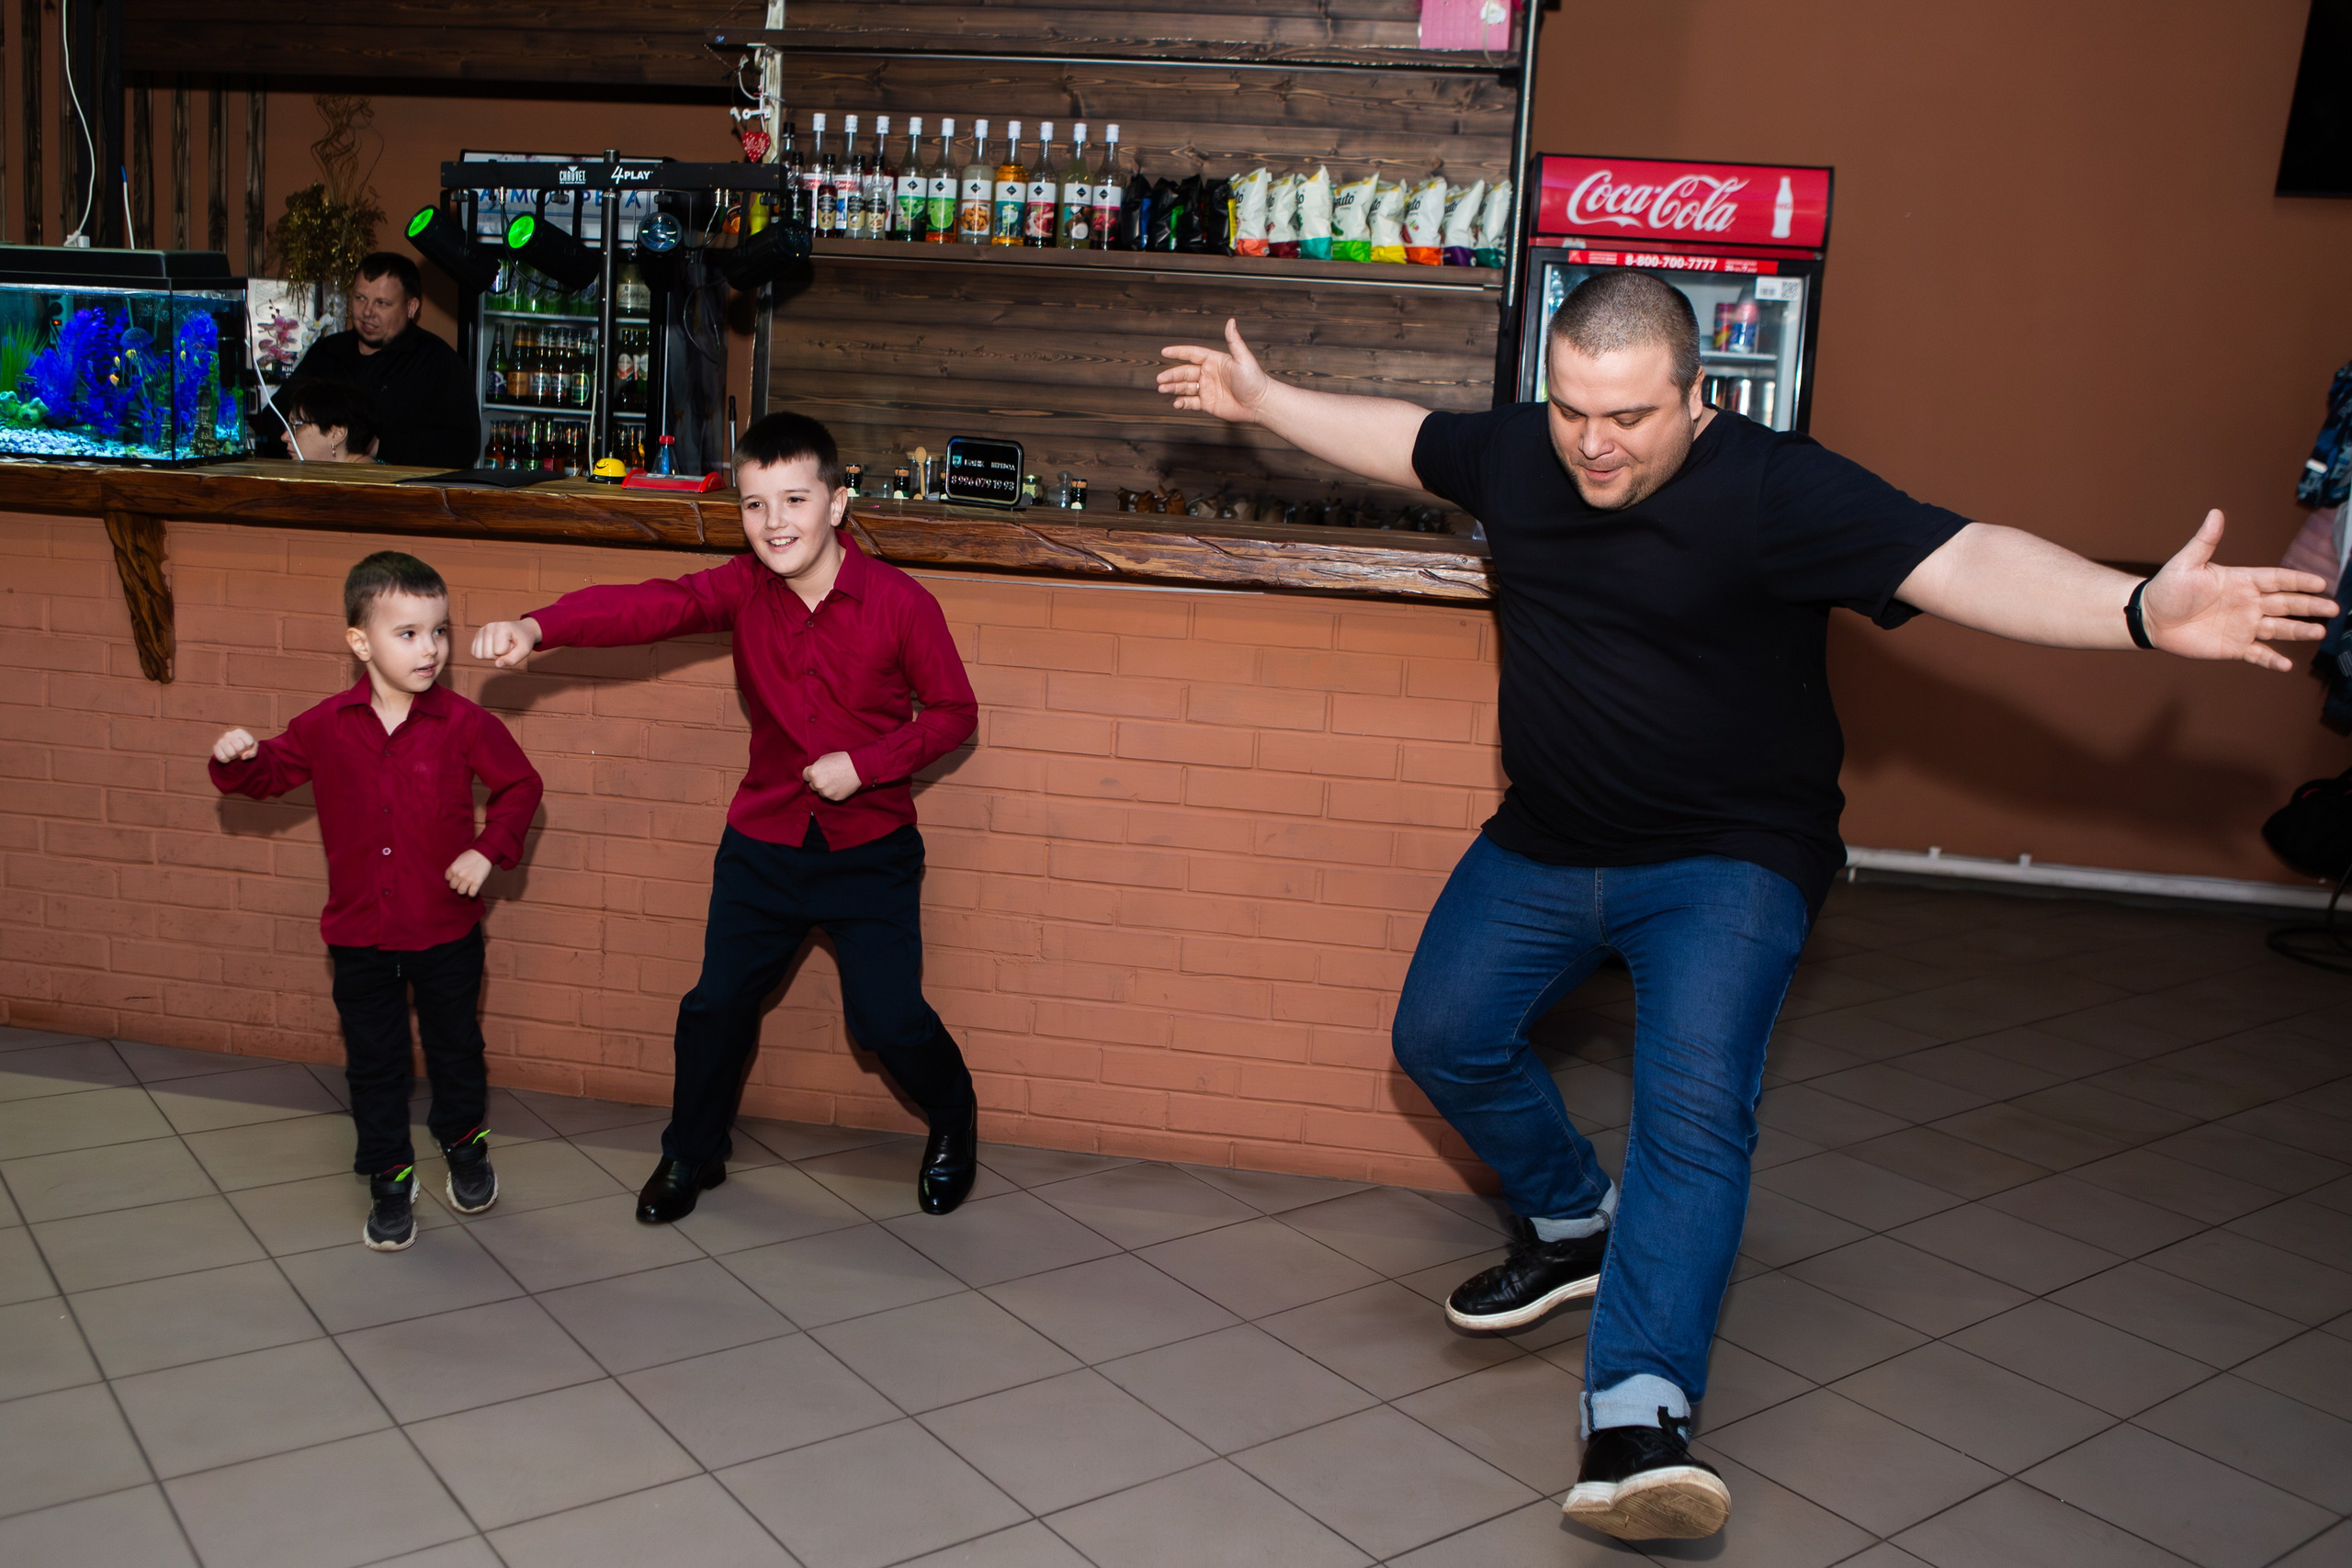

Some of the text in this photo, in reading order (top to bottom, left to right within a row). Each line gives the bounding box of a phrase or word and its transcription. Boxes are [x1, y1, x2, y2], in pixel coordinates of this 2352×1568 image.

[560, 170, 586, 182] CHAUVET
[610, 165, 650, 185] 4PLAY
[1566, 170, 1750, 232] Coca-Cola
[1624, 254, 1718, 272] 8-800-700-7777
[951, 475, 1015, 491] 8 996 079 19 93
